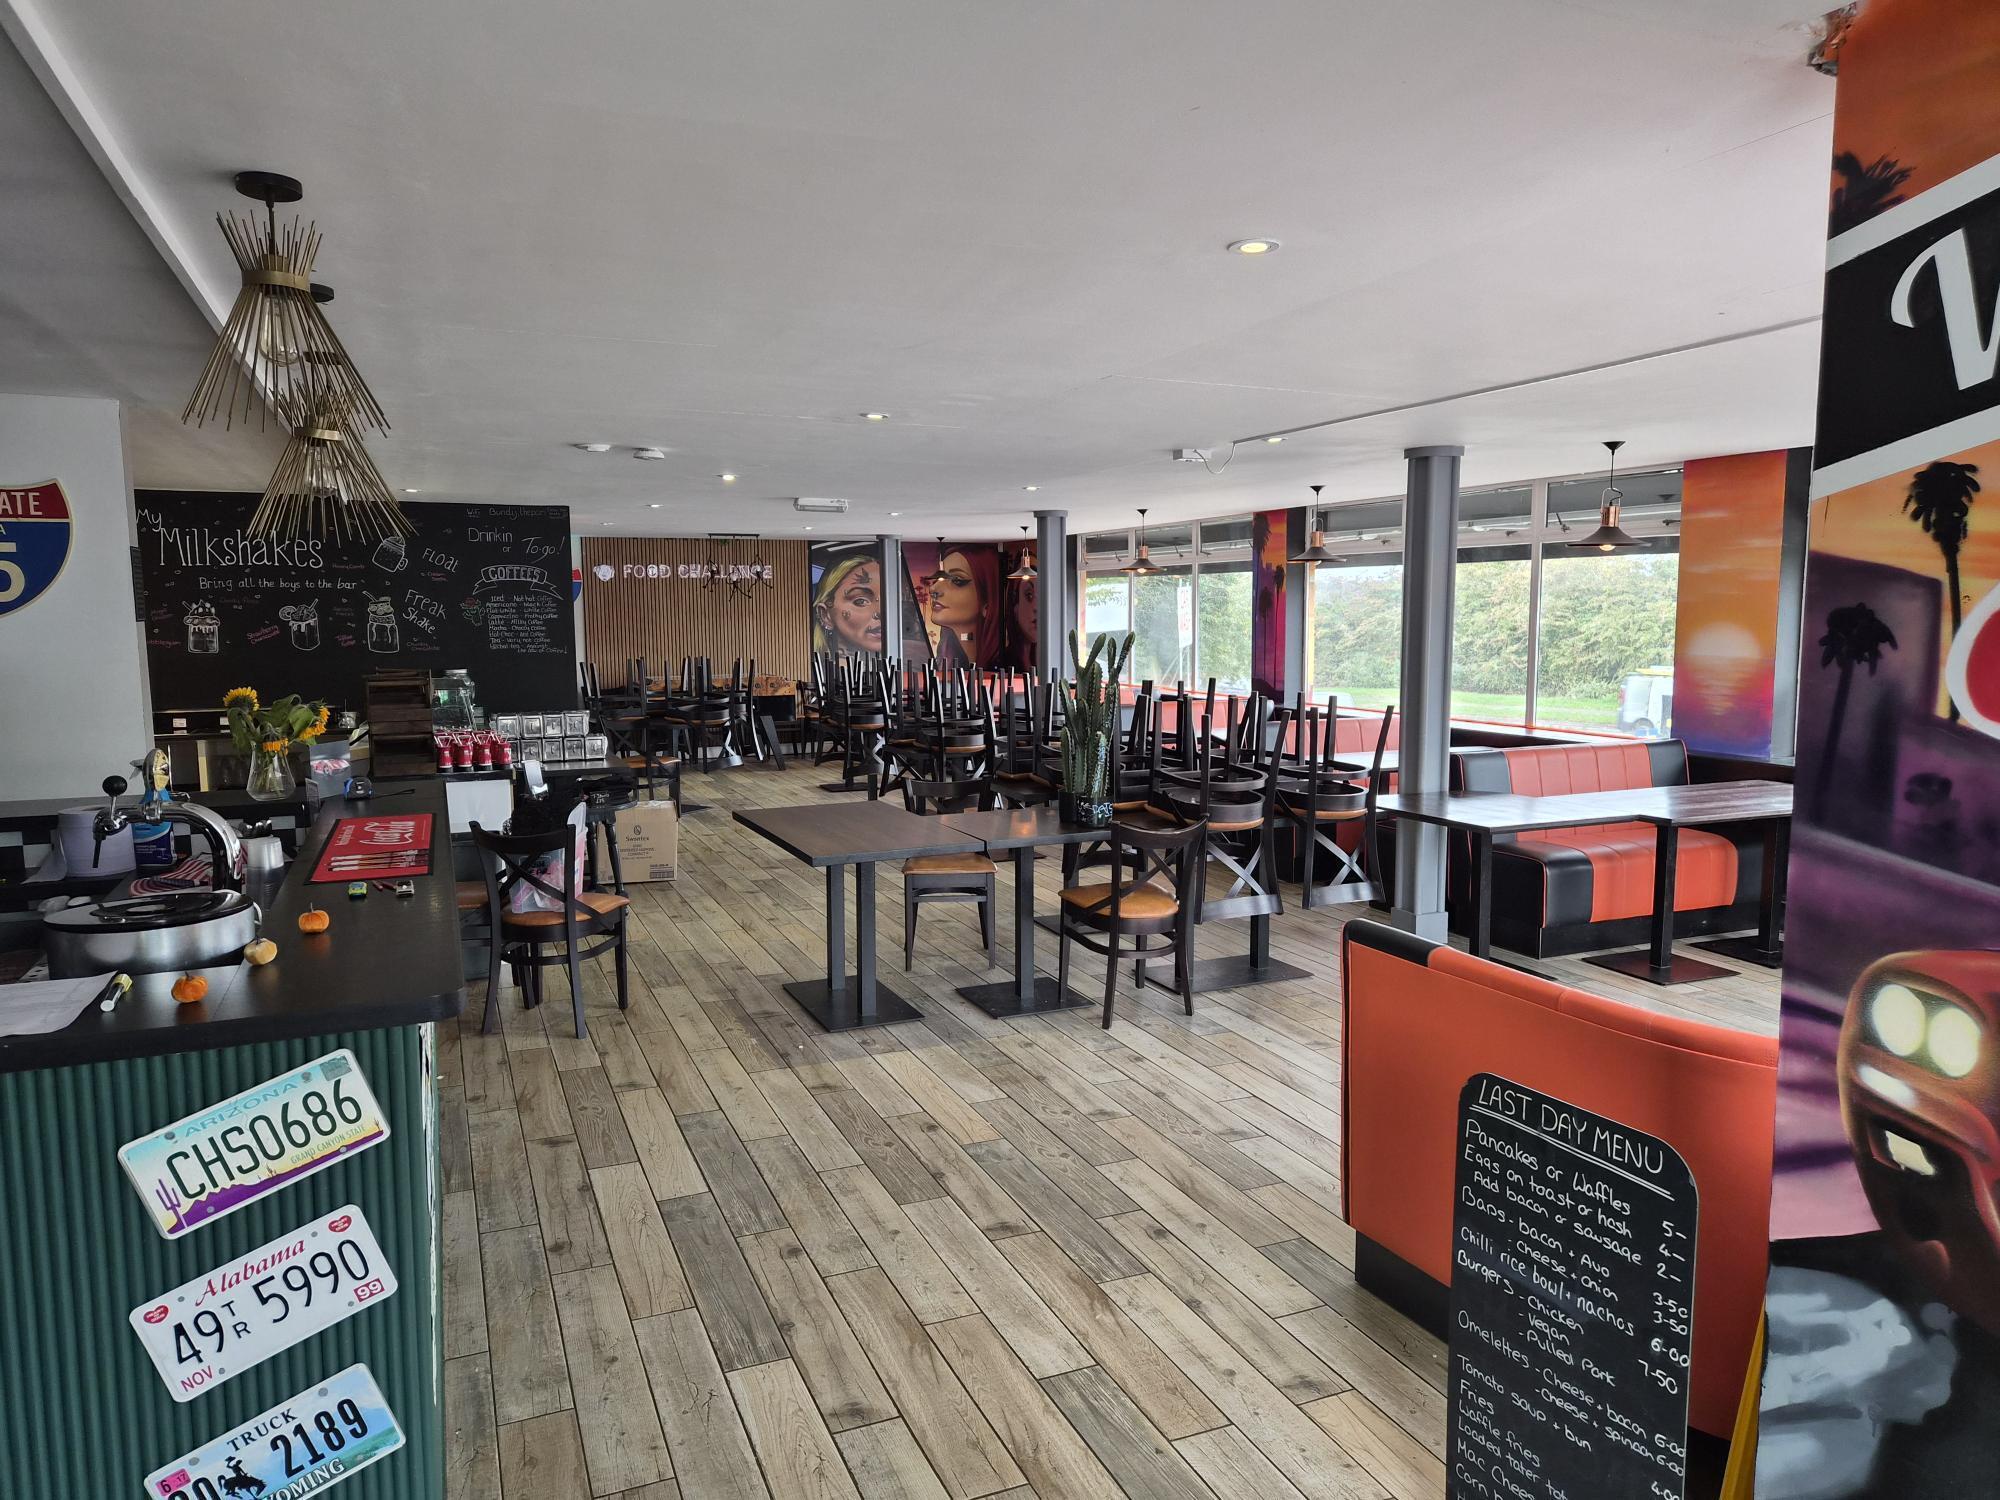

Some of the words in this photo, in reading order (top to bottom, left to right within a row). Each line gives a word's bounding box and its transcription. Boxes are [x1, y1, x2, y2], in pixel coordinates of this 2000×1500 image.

[136, 508, 162, 533] My
[159, 527, 324, 569] Milkshakes
[199, 577, 233, 592] Bring
[238, 578, 256, 588] all
[258, 577, 275, 588] the
[279, 578, 301, 590] boys
[304, 578, 315, 588] to
[317, 578, 333, 588] the
[337, 577, 358, 589] bar
[488, 566, 541, 582] COFFEES
[623, 564, 672, 579] FOOD
[402, 607, 436, 634] Shake
[404, 589, 448, 620] Freak
[185, 1081, 298, 1138] ARIZONA
[1478, 1079, 1532, 1120] LAST
[1541, 1104, 1587, 1145] DAY
[1593, 1126, 1663, 1174] MENU
[290, 1149, 316, 1165] GRAND
[317, 1136, 346, 1158] CANYON
[346, 1125, 366, 1141] STATE
[1465, 1118, 1539, 1170] Pancakes
[1546, 1165, 1564, 1181] or
[1573, 1172, 1632, 1216] Waffles
[1474, 1171, 1500, 1193] Add
[1506, 1187, 1549, 1218] bacon
[1555, 1214, 1567, 1225] or
[1574, 1222, 1643, 1267] sausage
[1506, 1170, 1524, 1187] on
[1529, 1176, 1575, 1209] toast
[1578, 1205, 1592, 1216] or
[1598, 1207, 1633, 1239] hash
[1518, 1217, 1562, 1253] bacon
[1580, 1254, 1610, 1278] Avo
[195, 1240, 306, 1307] Alabama
[355, 1280, 383, 1300] 99
[1457, 1249, 1515, 1295] Burgers
[1461, 1226, 1493, 1255] Chilli
[1500, 1252, 1527, 1277] rice
[1533, 1265, 1564, 1300] bowl
[1576, 1297, 1635, 1337] nachos
[1516, 1240, 1569, 1279] cheese
[1581, 1275, 1618, 1302] onion
[173, 1310, 225, 1365] 49
[252, 1239, 370, 1324] 5990
[181, 1366, 214, 1392] NOV
[1457, 1310, 1530, 1369] Omelettes
[1606, 1403, 1647, 1440] bacon
[1581, 1358, 1617, 1388] Pork
[1457, 1353, 1504, 1395] Tomato
[1511, 1392, 1547, 1422] soup
[1564, 1424, 1592, 1452] bun
[1459, 1379, 1495, 1415] Fries
[226, 1408, 298, 1452] TRUCK
[270, 1398, 369, 1479] 2189
[1458, 1399, 1501, 1440] Waffle
[1506, 1430, 1541, 1468] fries
[1458, 1416, 1502, 1458] Loaded
[1505, 1452, 1541, 1483] tater
[1457, 1438, 1486, 1472] Mac
[160, 1480, 172, 1493] 6
[1455, 1463, 1489, 1498] Corn
